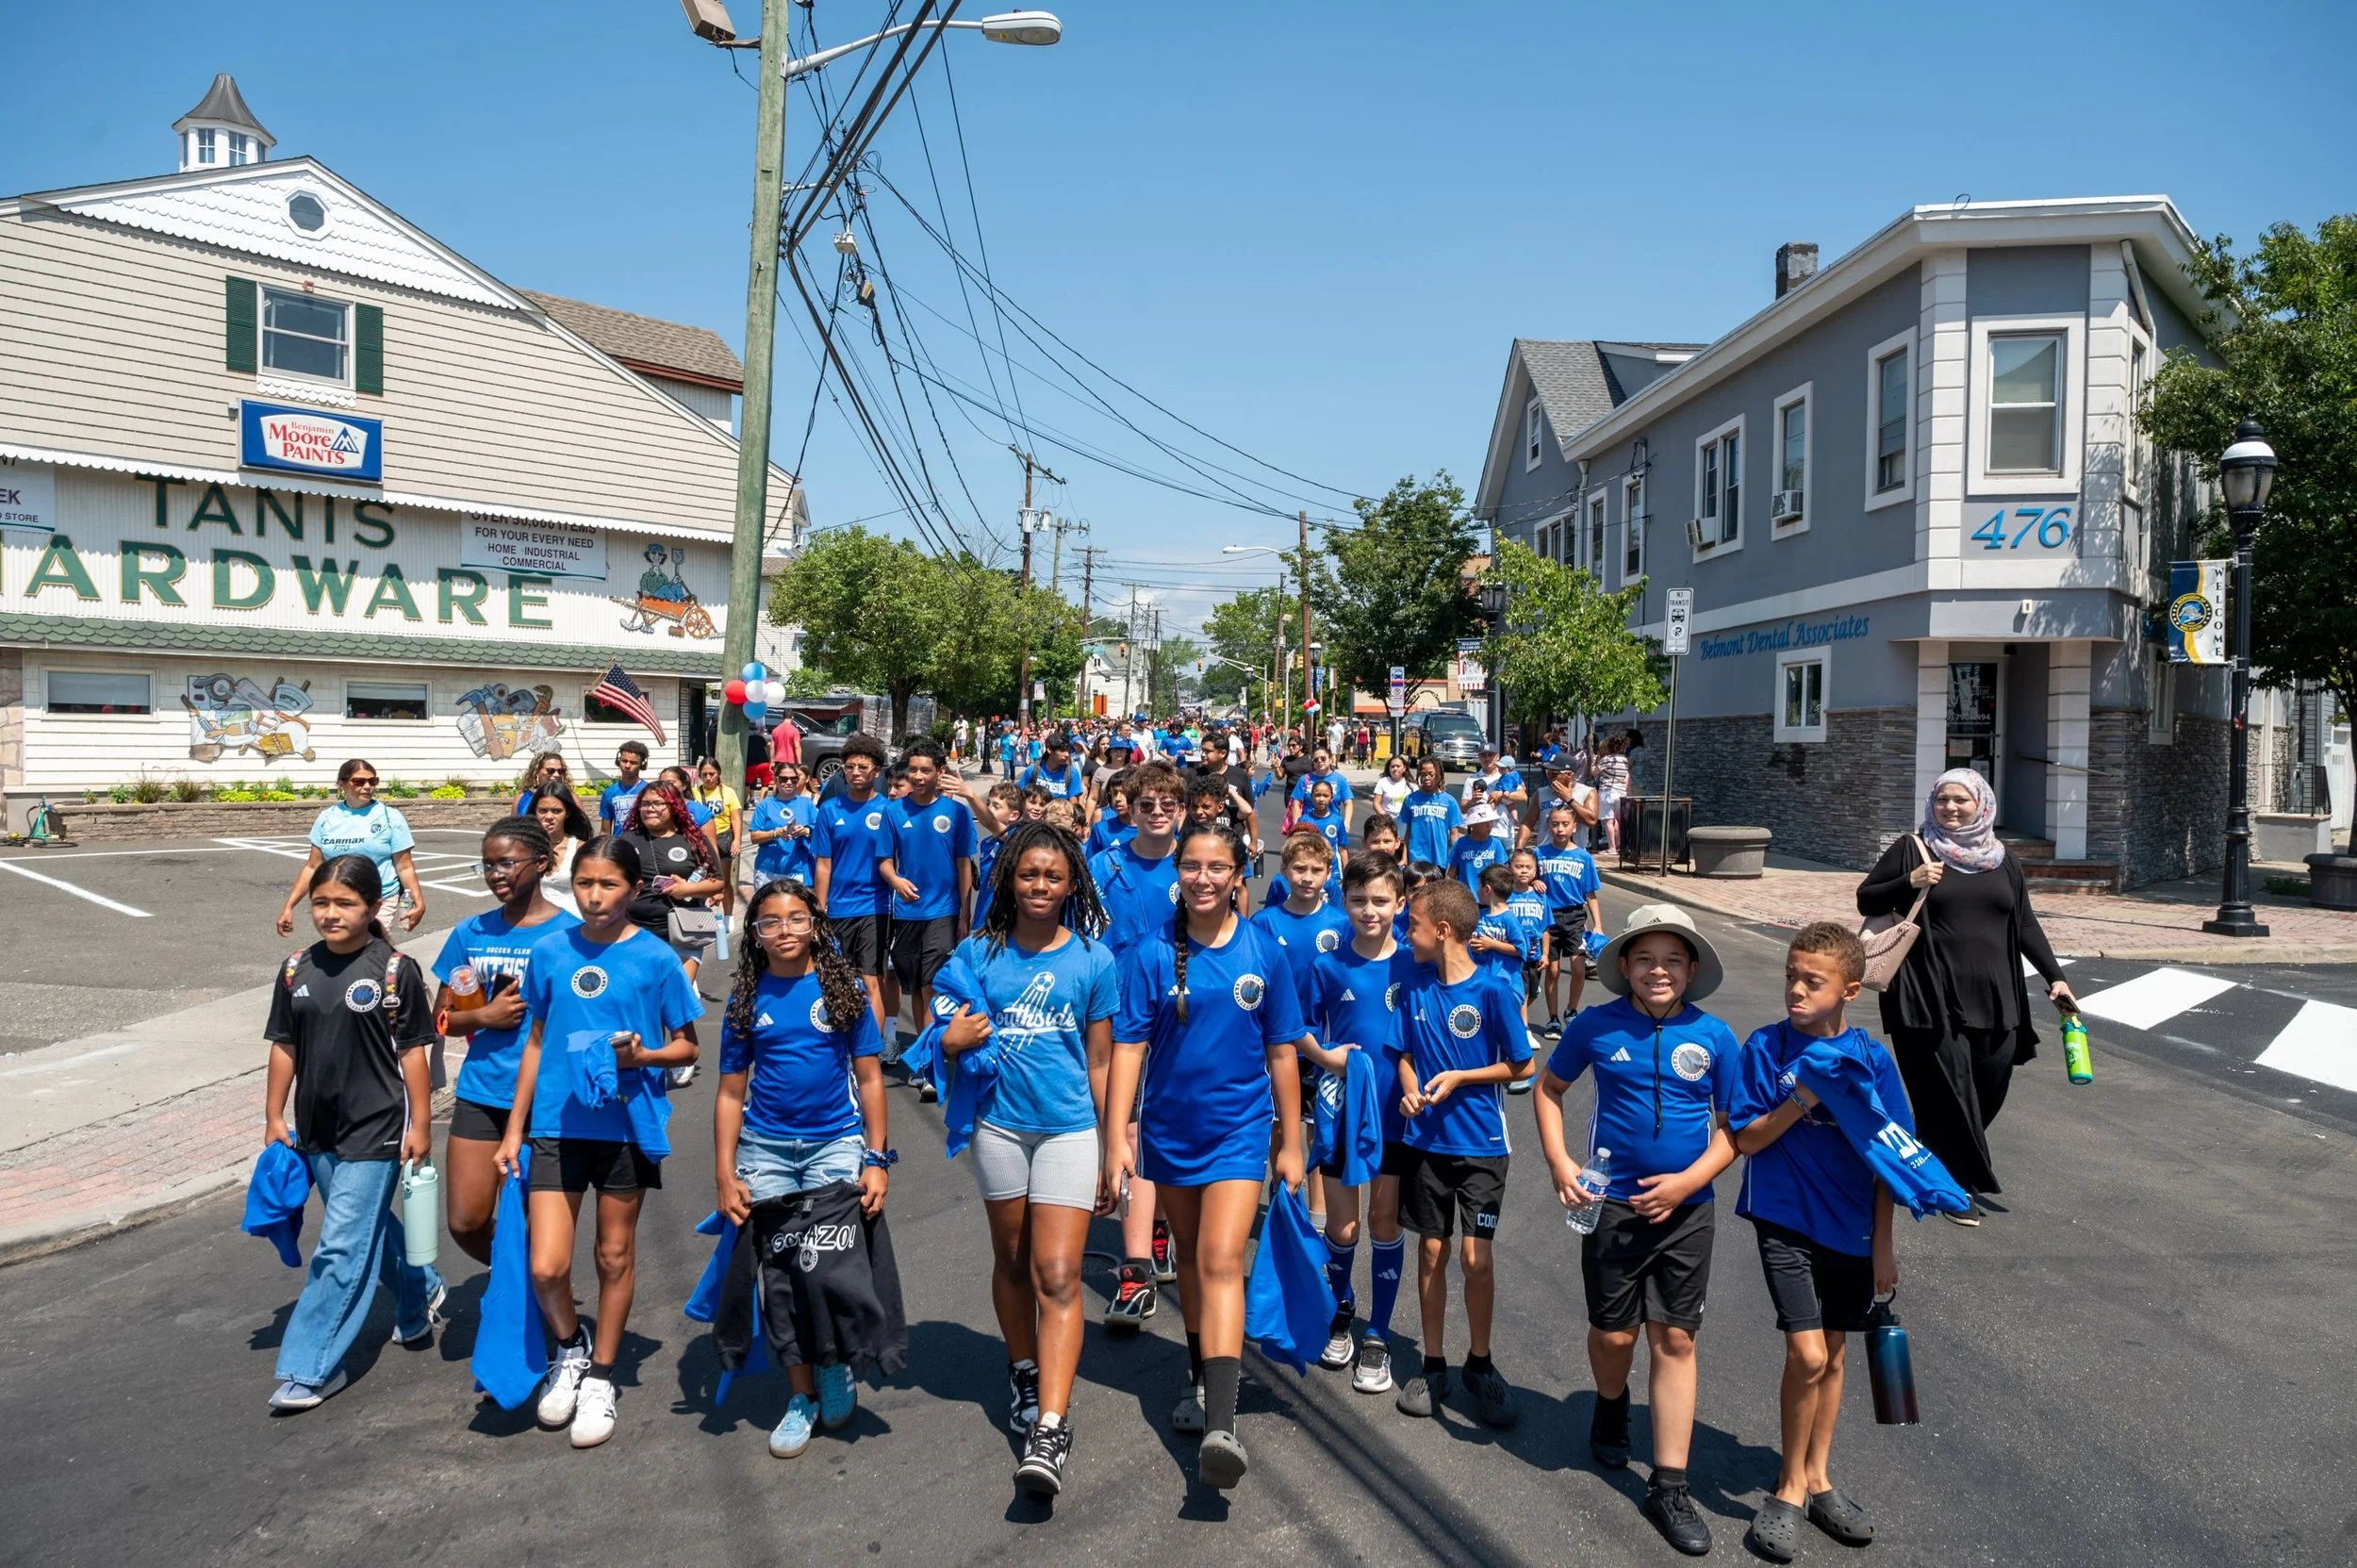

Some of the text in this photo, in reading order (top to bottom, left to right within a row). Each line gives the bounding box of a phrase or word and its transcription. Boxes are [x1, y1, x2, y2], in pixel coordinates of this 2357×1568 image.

[269, 422, 332, 447] Moore
[291, 421, 334, 435] Benjamin
[283, 442, 345, 465] PAINTS
[5, 512, 39, 523] STORE
[135, 472, 394, 549] TANIS
[475, 526, 594, 549] FOR YOUR EVERY NEED
[1970, 506, 2072, 550] 476
[487, 543, 581, 561] HOME INDUSTRIAL
[502, 556, 567, 571] COMMERCIAL
[0, 529, 553, 629] ARDWARE
[2213, 568, 2224, 657] WELCOME
[1700, 615, 1870, 660] Belmont Dental Associates
